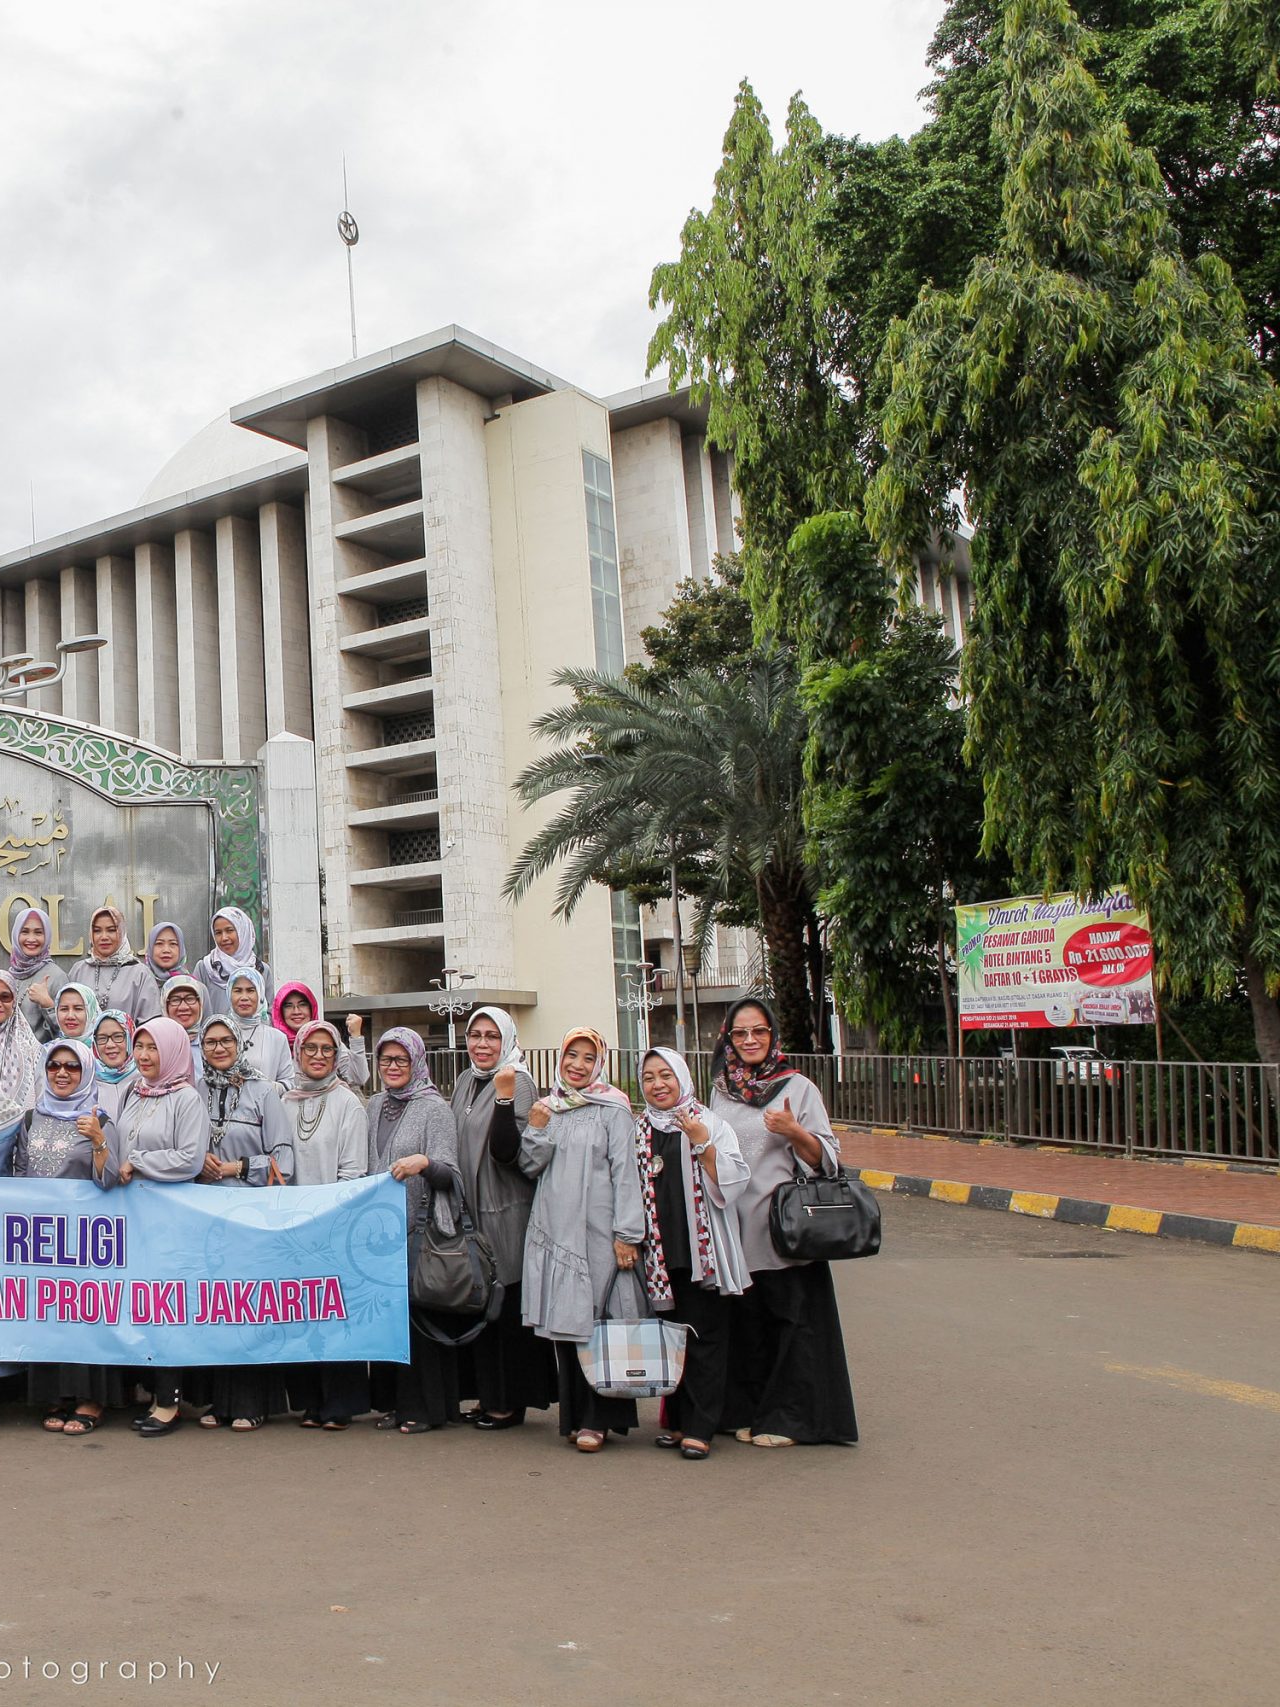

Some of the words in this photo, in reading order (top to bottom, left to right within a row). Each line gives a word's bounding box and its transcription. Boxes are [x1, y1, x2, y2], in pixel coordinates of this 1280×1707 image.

[988, 903, 1028, 926] Umroh
[961, 934, 981, 956] PROMO
[983, 932, 1020, 949] PESAWAT
[1021, 928, 1055, 945] GARUDA
[1089, 930, 1121, 945] HANYA
[984, 954, 1005, 968] HOTEL
[1006, 950, 1043, 966] BINTANG
[1045, 949, 1051, 963] 5
[1102, 964, 1115, 974] ALL
[984, 972, 1011, 987] DAFTAR
[1012, 971, 1021, 985] 10
[1038, 967, 1078, 984] GRATIS
[3, 1212, 127, 1269] RELIGI
[36, 1276, 124, 1326] PROV
[130, 1278, 187, 1325] DKI
[193, 1275, 348, 1326] JAKARTA
